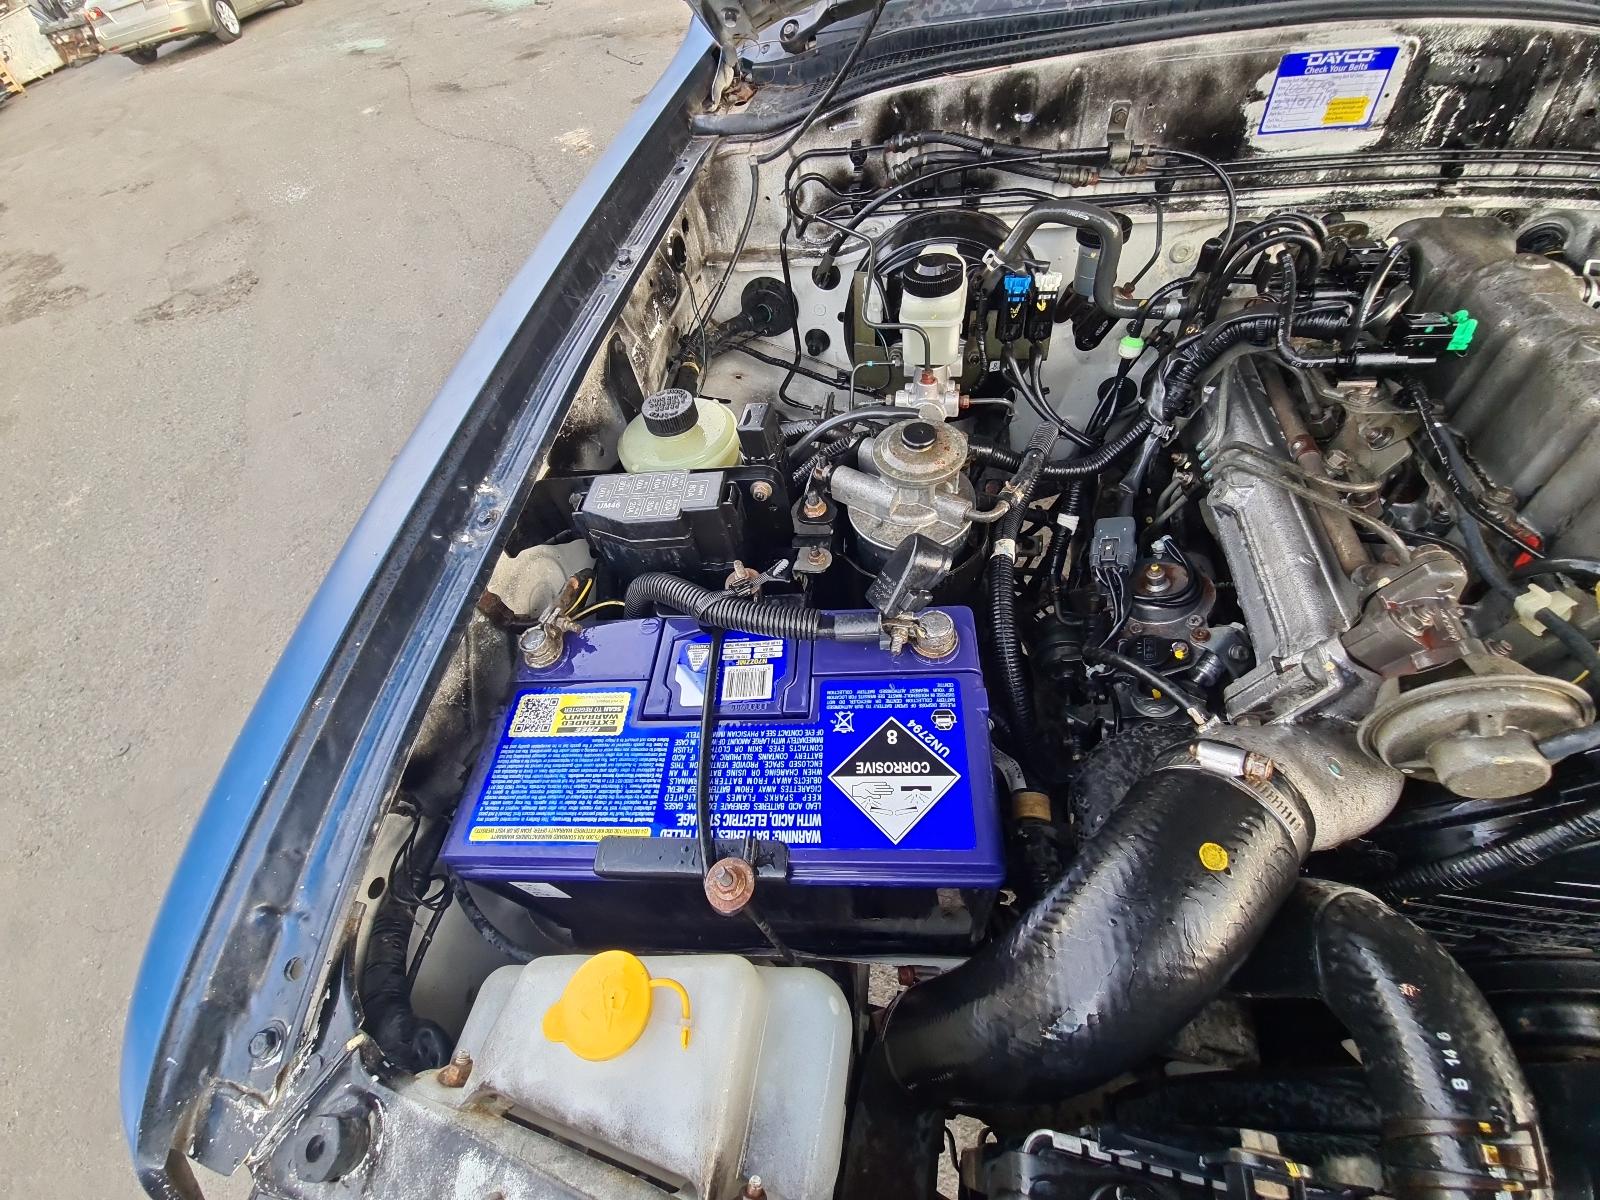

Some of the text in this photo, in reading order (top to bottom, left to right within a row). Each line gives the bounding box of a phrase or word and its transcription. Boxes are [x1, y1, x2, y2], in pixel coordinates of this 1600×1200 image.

[1304, 50, 1377, 66] DAYCO
[1304, 62, 1369, 74] Check Your Belts
[887, 730, 898, 744] 8
[907, 719, 950, 758] UN2794
[855, 761, 930, 773] CORROSIVE
[676, 812, 821, 826] WITH ACID, ELECTRIC STAGE.
[772, 830, 821, 843] WARNING:
[1441, 1049, 1461, 1066] 14
[1451, 1078, 1468, 1091] B
